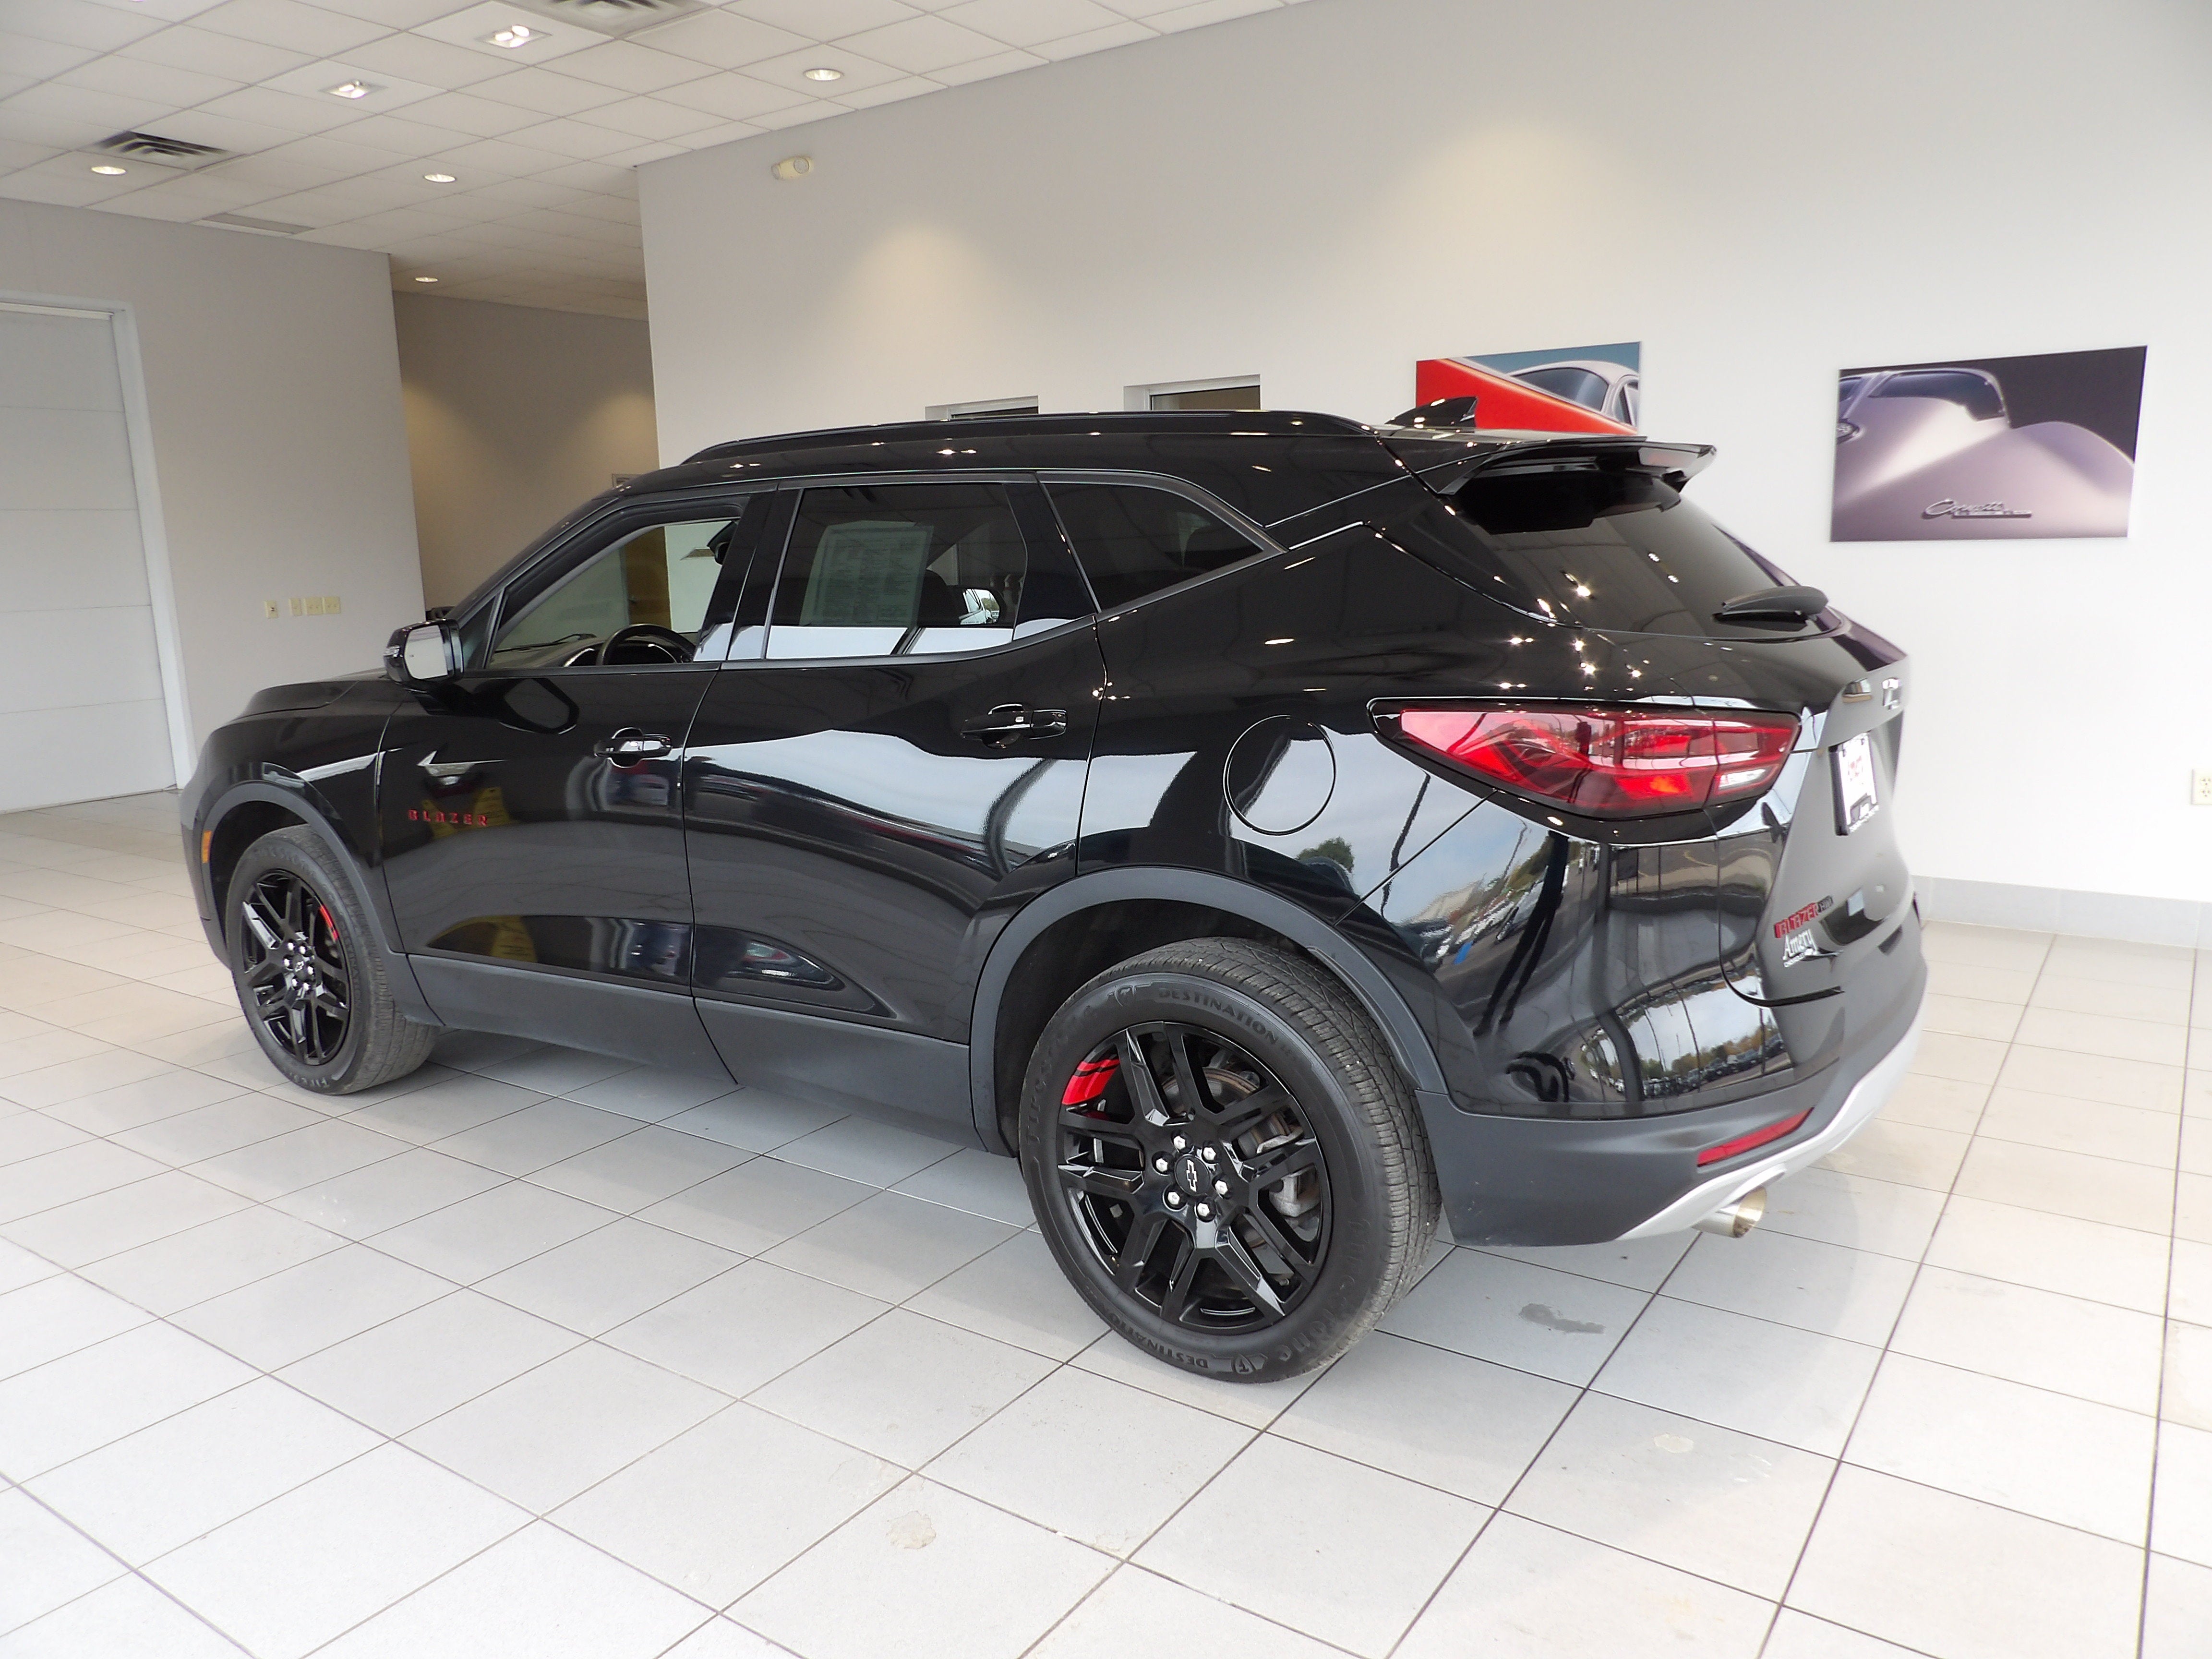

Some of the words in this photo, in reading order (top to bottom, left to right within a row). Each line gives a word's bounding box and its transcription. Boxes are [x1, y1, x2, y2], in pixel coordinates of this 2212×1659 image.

[408, 809, 488, 827] BLAZER
[1774, 902, 1819, 938] BLAZER
[1158, 989, 1279, 1045] DESTINATION
